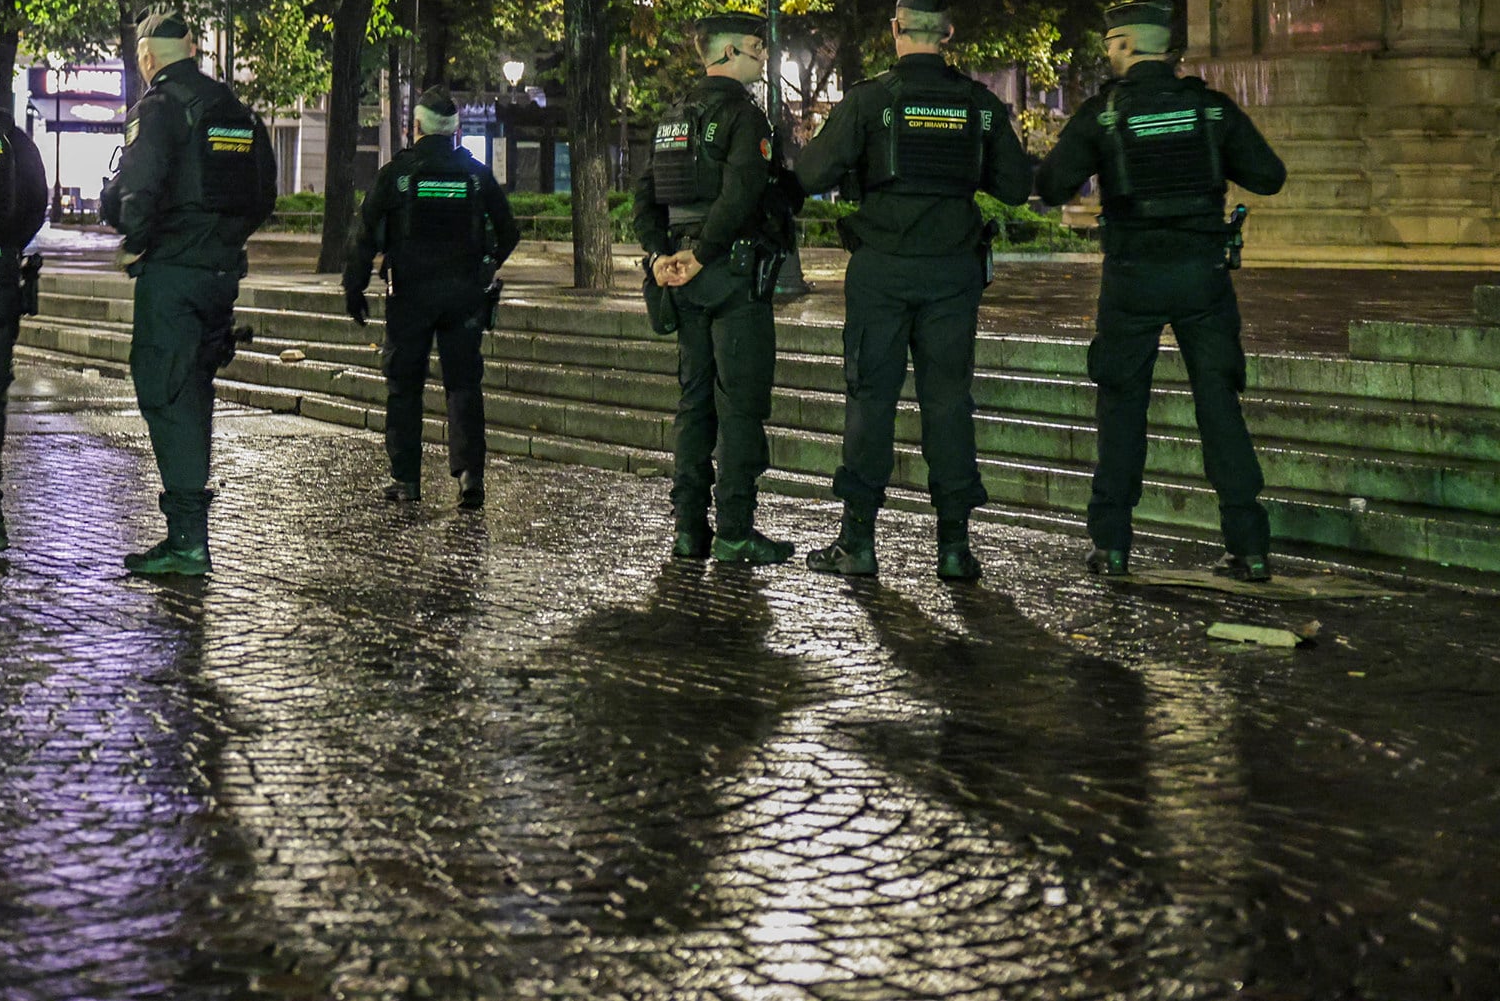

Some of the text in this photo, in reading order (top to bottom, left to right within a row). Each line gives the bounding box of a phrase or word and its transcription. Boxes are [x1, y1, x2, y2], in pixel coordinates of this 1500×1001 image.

[904, 106, 968, 118] GENDARMERIE
[1127, 108, 1197, 125] GENDARMERIE
[671, 122, 690, 137] 26/3
